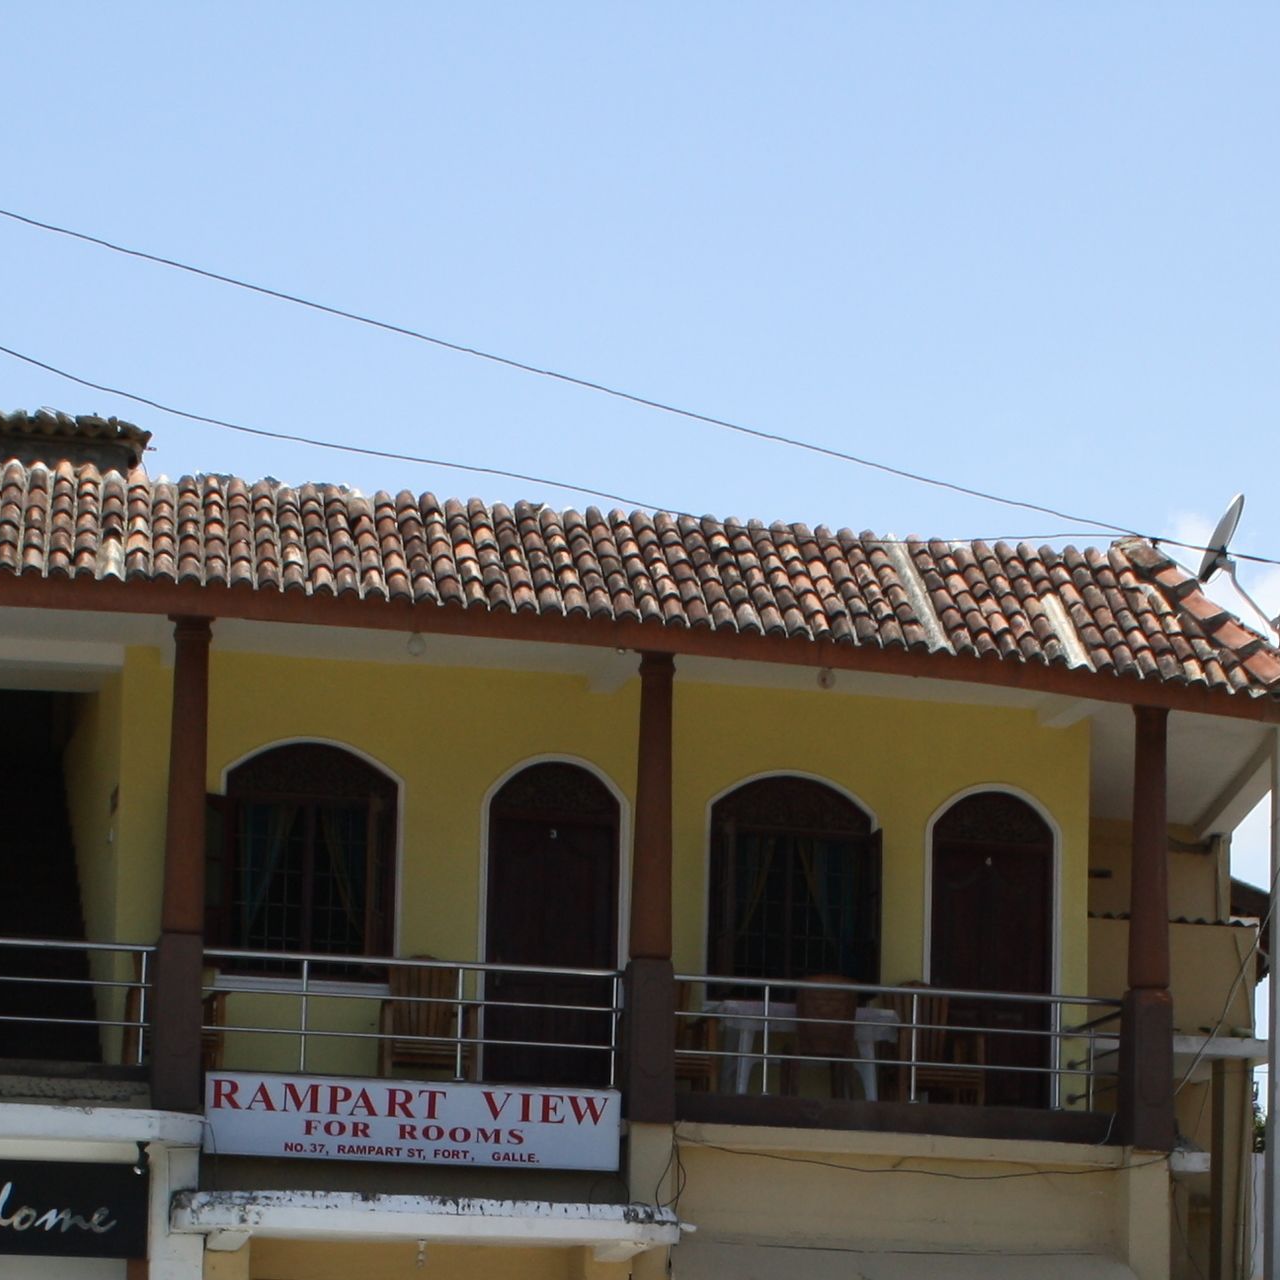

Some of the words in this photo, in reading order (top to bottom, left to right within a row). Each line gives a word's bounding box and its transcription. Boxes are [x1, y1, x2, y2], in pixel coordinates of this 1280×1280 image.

[210, 1078, 447, 1120] RAMPART
[481, 1090, 609, 1126] VIEW
[303, 1119, 371, 1138] FOR
[398, 1123, 524, 1145] ROOMS
[337, 1144, 403, 1158] RAMPART
[406, 1147, 427, 1161] ST,
[433, 1149, 475, 1162] FORT,
[491, 1151, 540, 1164] GALLE.
